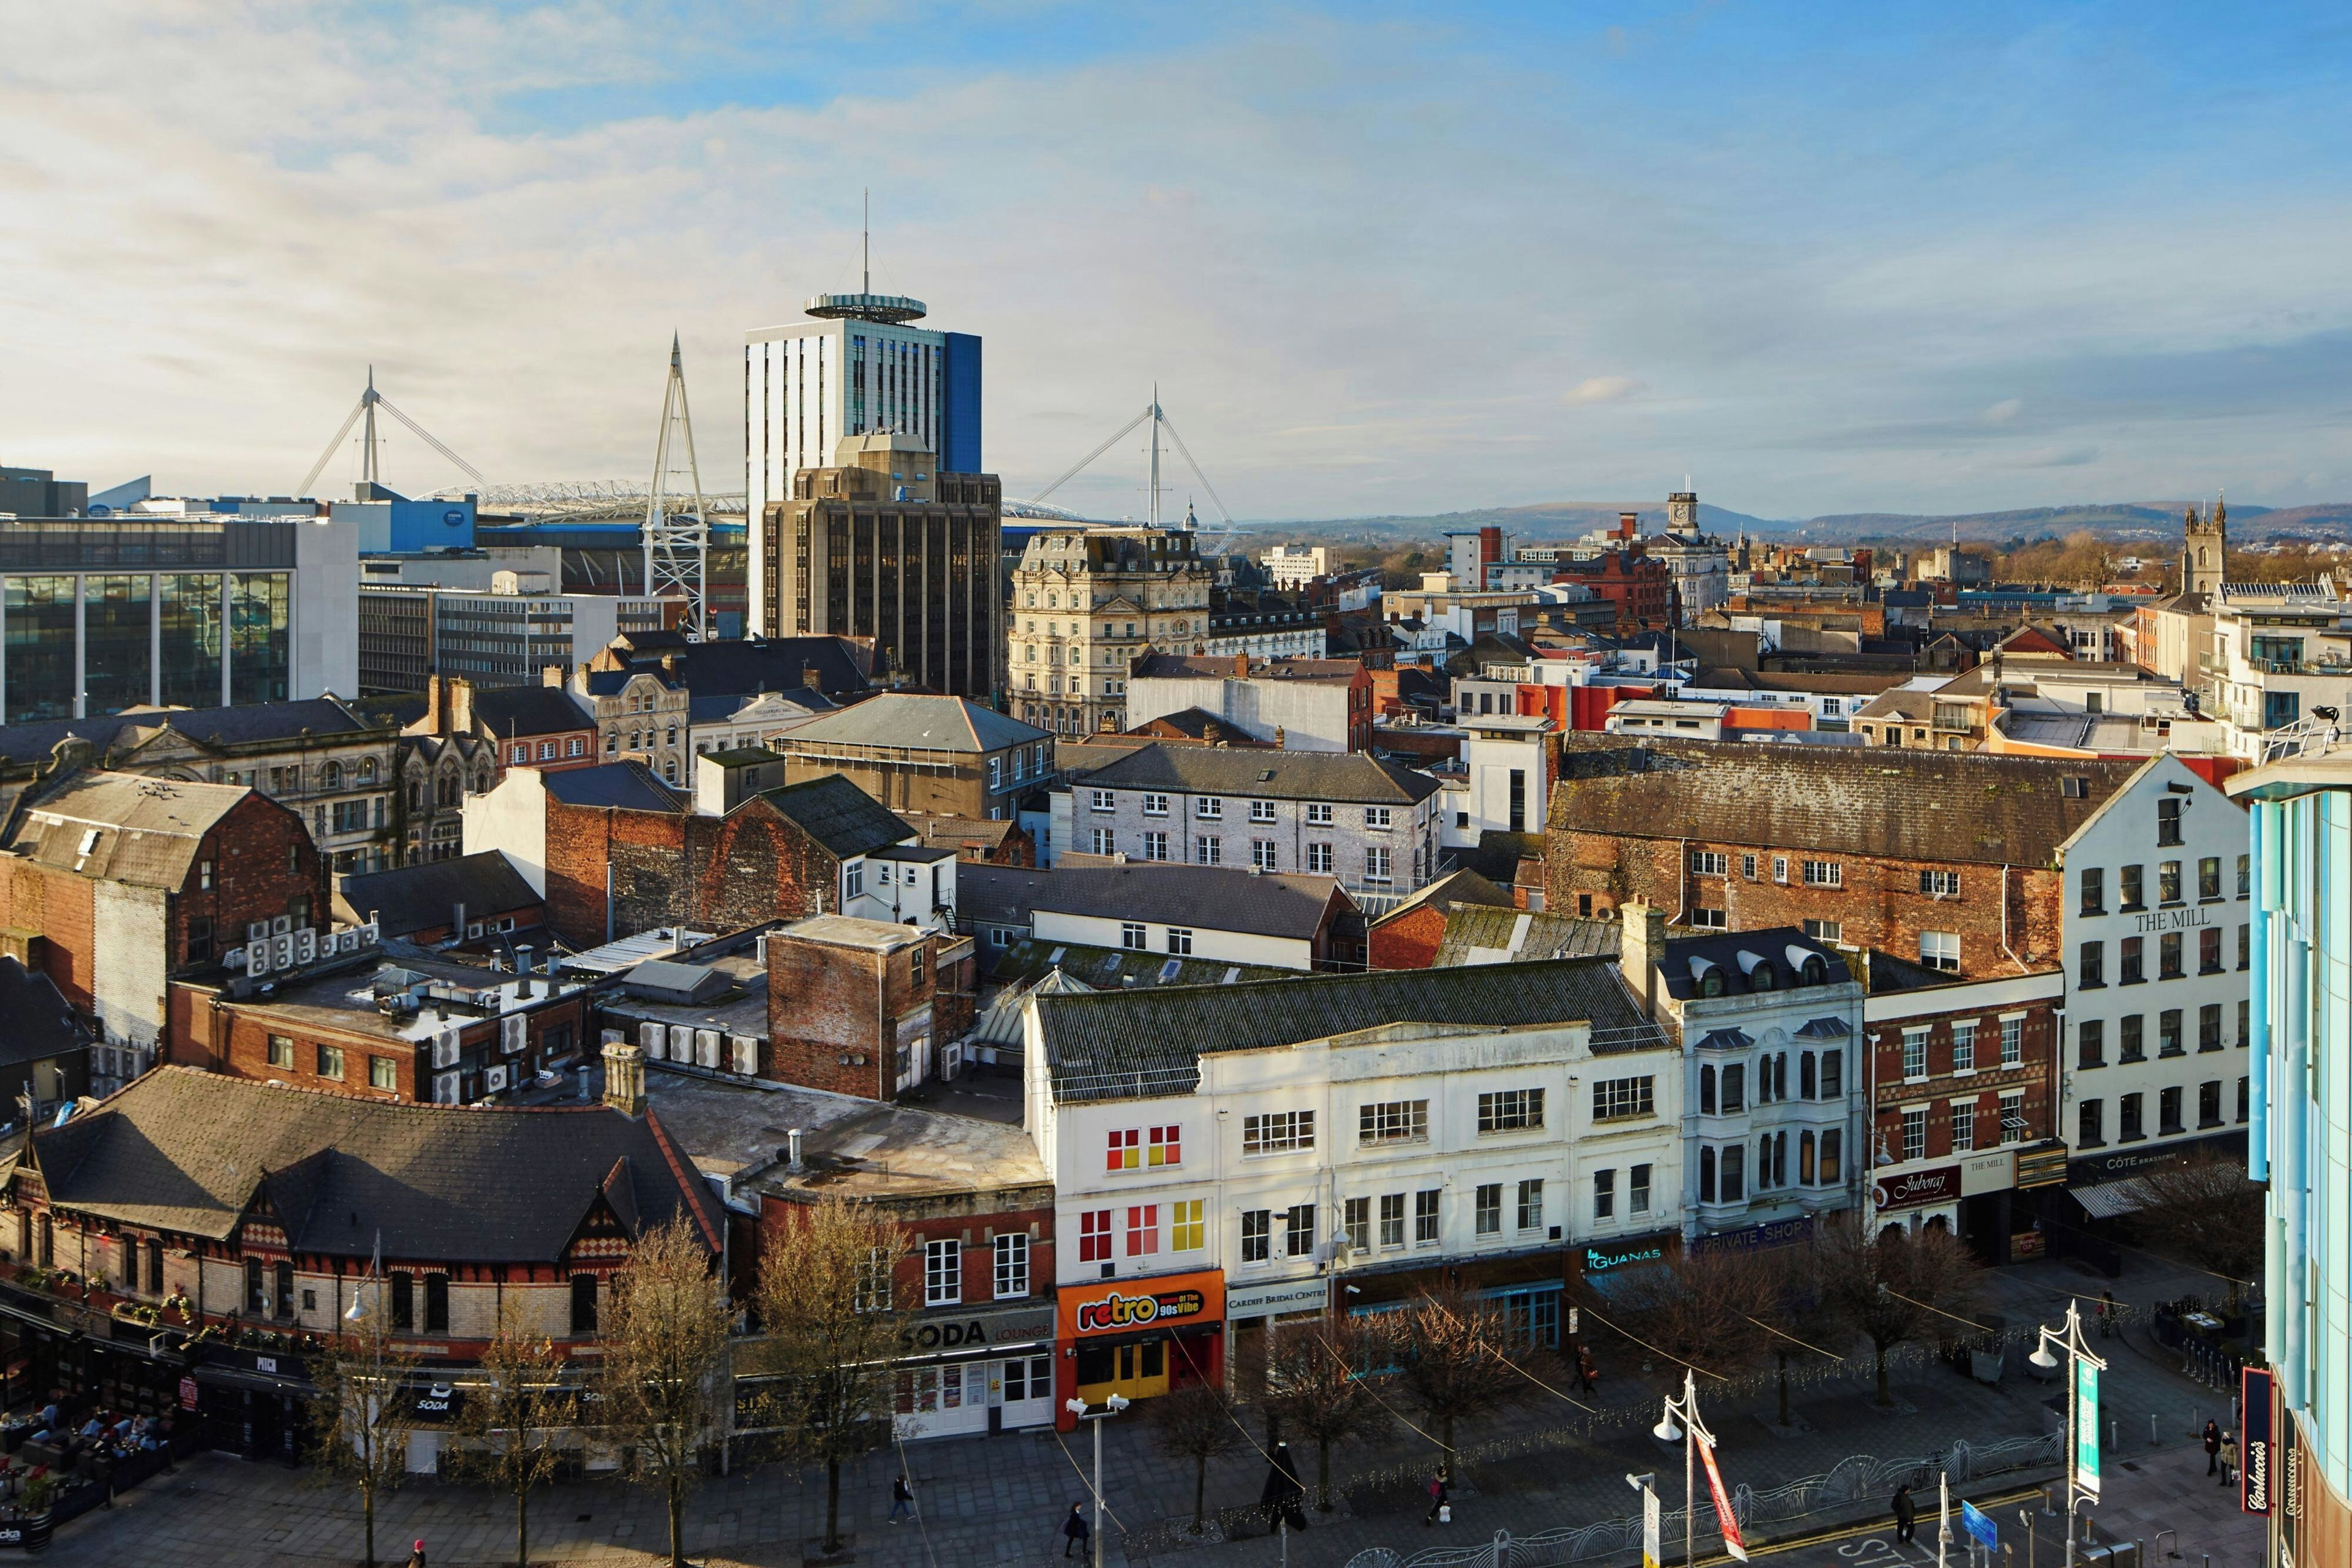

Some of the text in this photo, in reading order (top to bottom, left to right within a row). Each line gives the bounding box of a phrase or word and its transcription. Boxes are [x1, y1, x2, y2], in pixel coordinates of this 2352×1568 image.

[2136, 908, 2211, 932] THE MILL
[1971, 1158, 2004, 1171] THE MILL
[2106, 1156, 2138, 1170] CÔTE
[1894, 1172, 1946, 1199] Juboraj
[1703, 1222, 1803, 1254] PRIVATE SHOP
[1229, 1289, 1327, 1308] CARDIFF BRIDAL CENTRE
[1082, 1294, 1156, 1329] retro
[1160, 1302, 1199, 1316] 90s Vibe
[996, 1324, 1050, 1341] LOUNGE
[417, 1400, 449, 1410] SODA
[2248, 1441, 2267, 1510] Carluccio's
